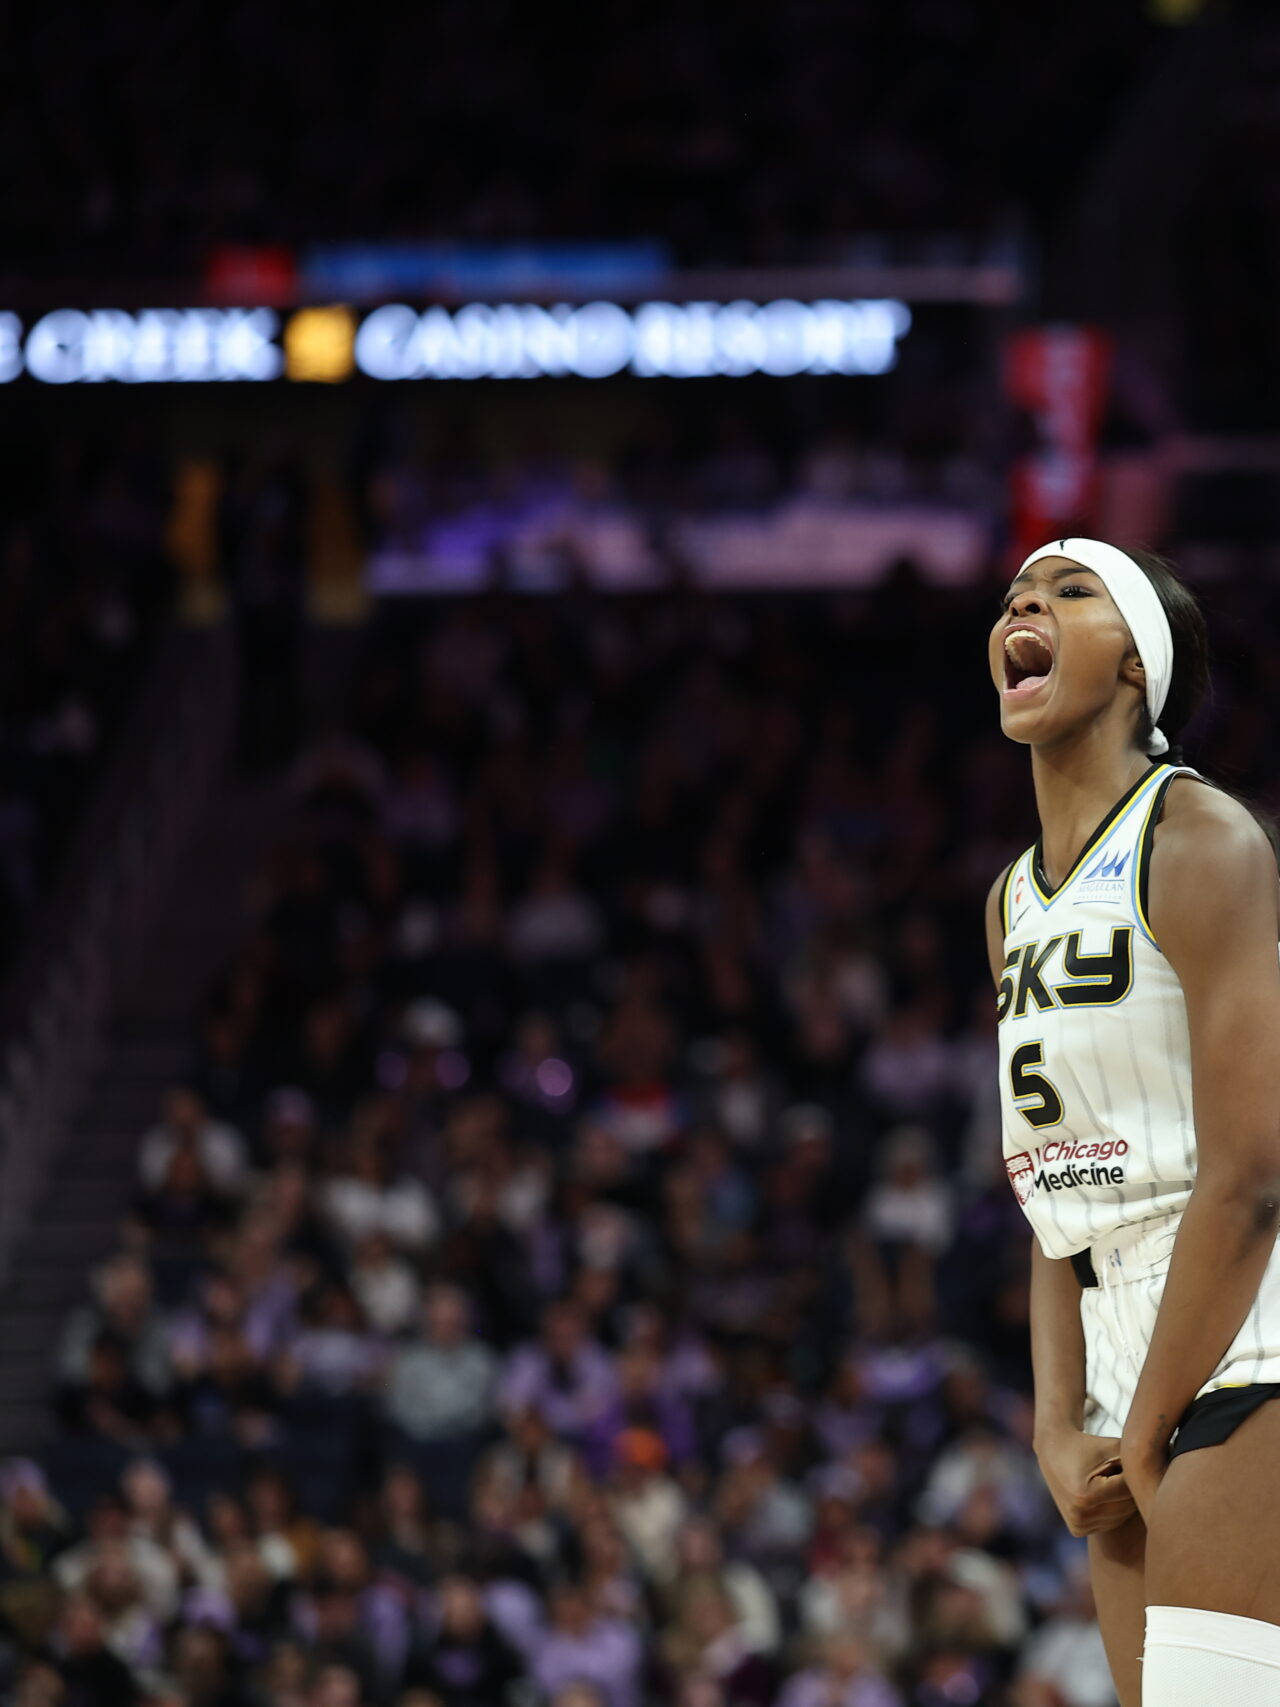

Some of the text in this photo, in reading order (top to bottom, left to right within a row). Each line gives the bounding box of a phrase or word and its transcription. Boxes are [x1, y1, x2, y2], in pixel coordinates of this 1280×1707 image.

[354, 300, 634, 380] CASINO
[632, 298, 911, 377] RESORT
[997, 926, 1135, 1025] SKY
[1009, 1039, 1065, 1130] 5
[1034, 1162, 1125, 1193] Medicine
